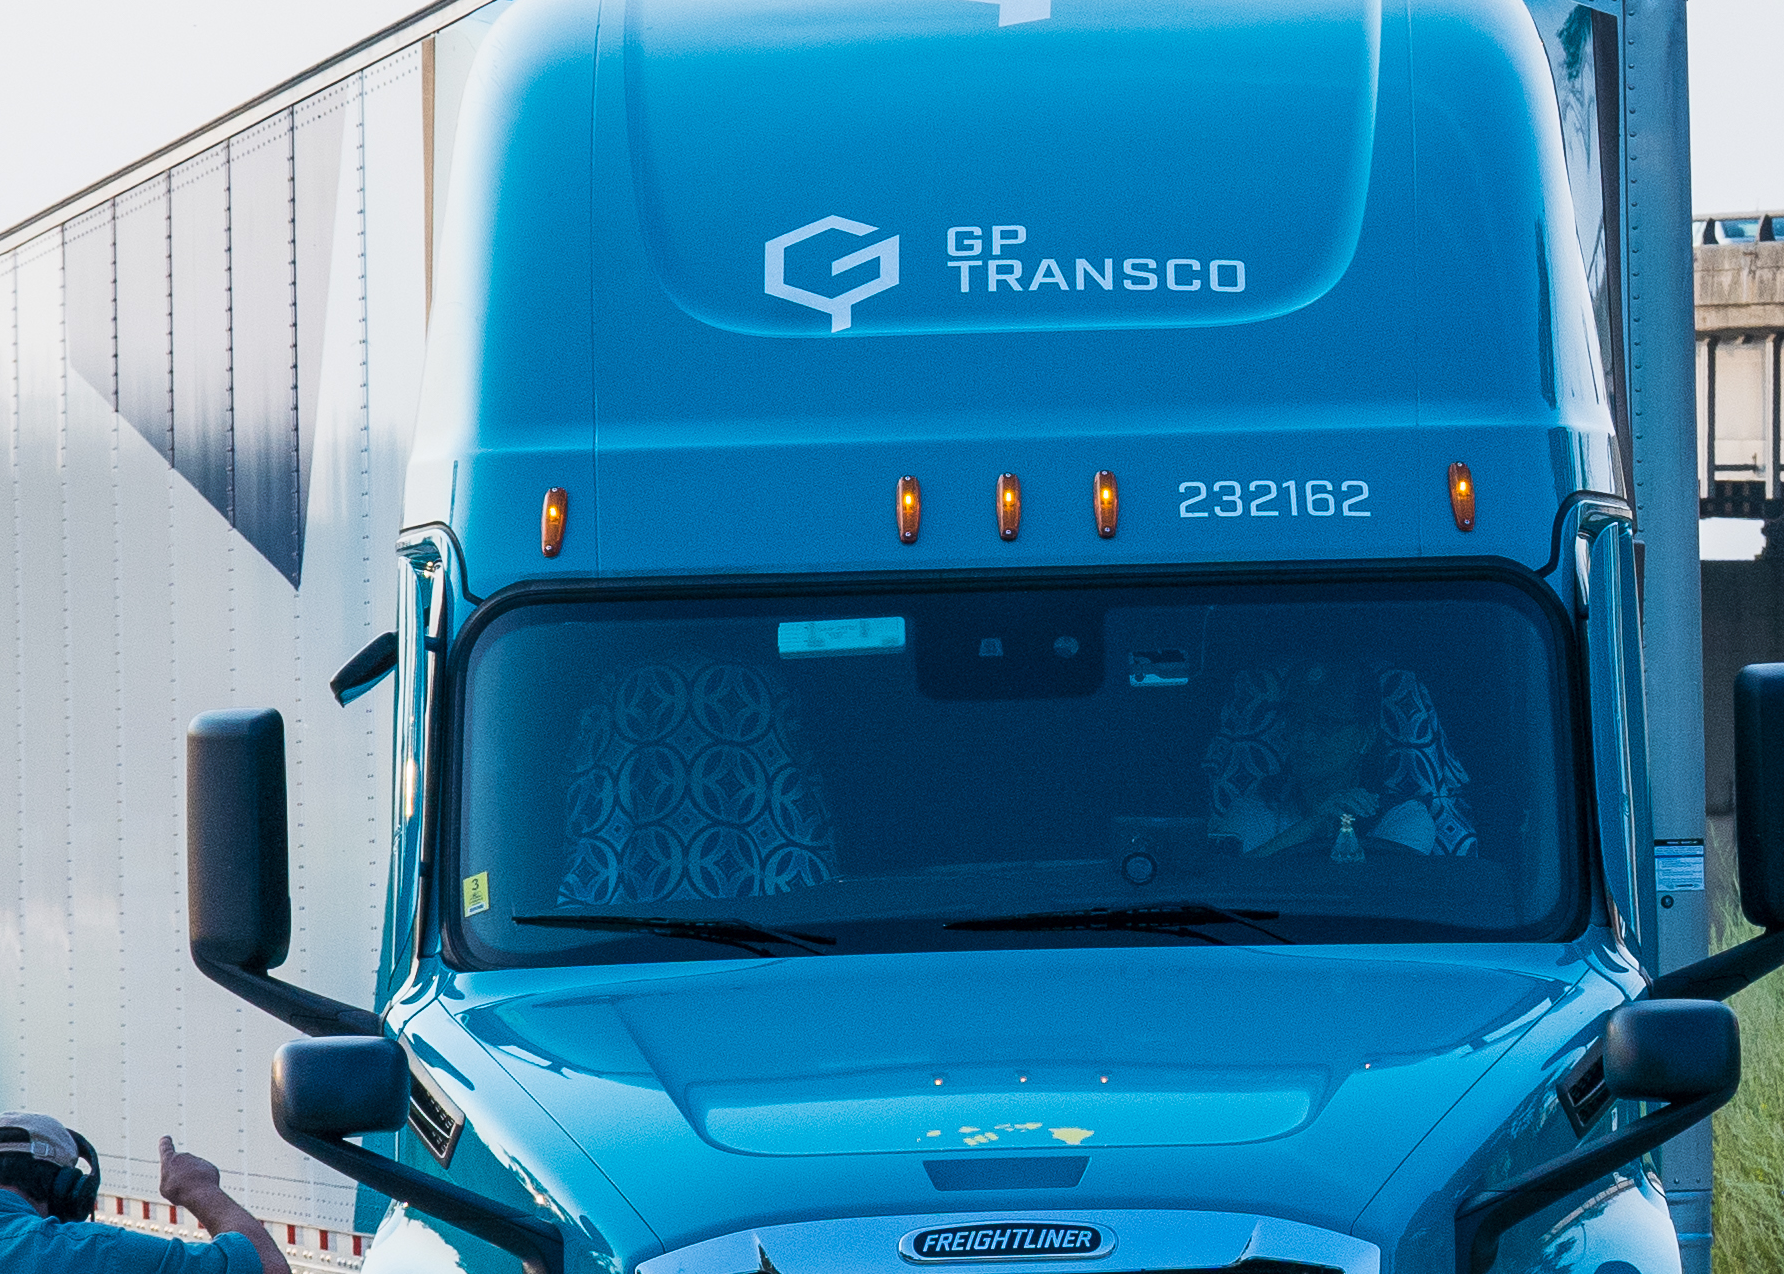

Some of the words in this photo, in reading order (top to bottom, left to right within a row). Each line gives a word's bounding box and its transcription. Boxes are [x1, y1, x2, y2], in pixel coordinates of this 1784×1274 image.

[947, 224, 1027, 257] GP
[947, 258, 1246, 294] TRANSCO
[1178, 480, 1372, 518] 232162
[471, 878, 480, 891] 3
[922, 1228, 1093, 1253] FREIGHTLINER
